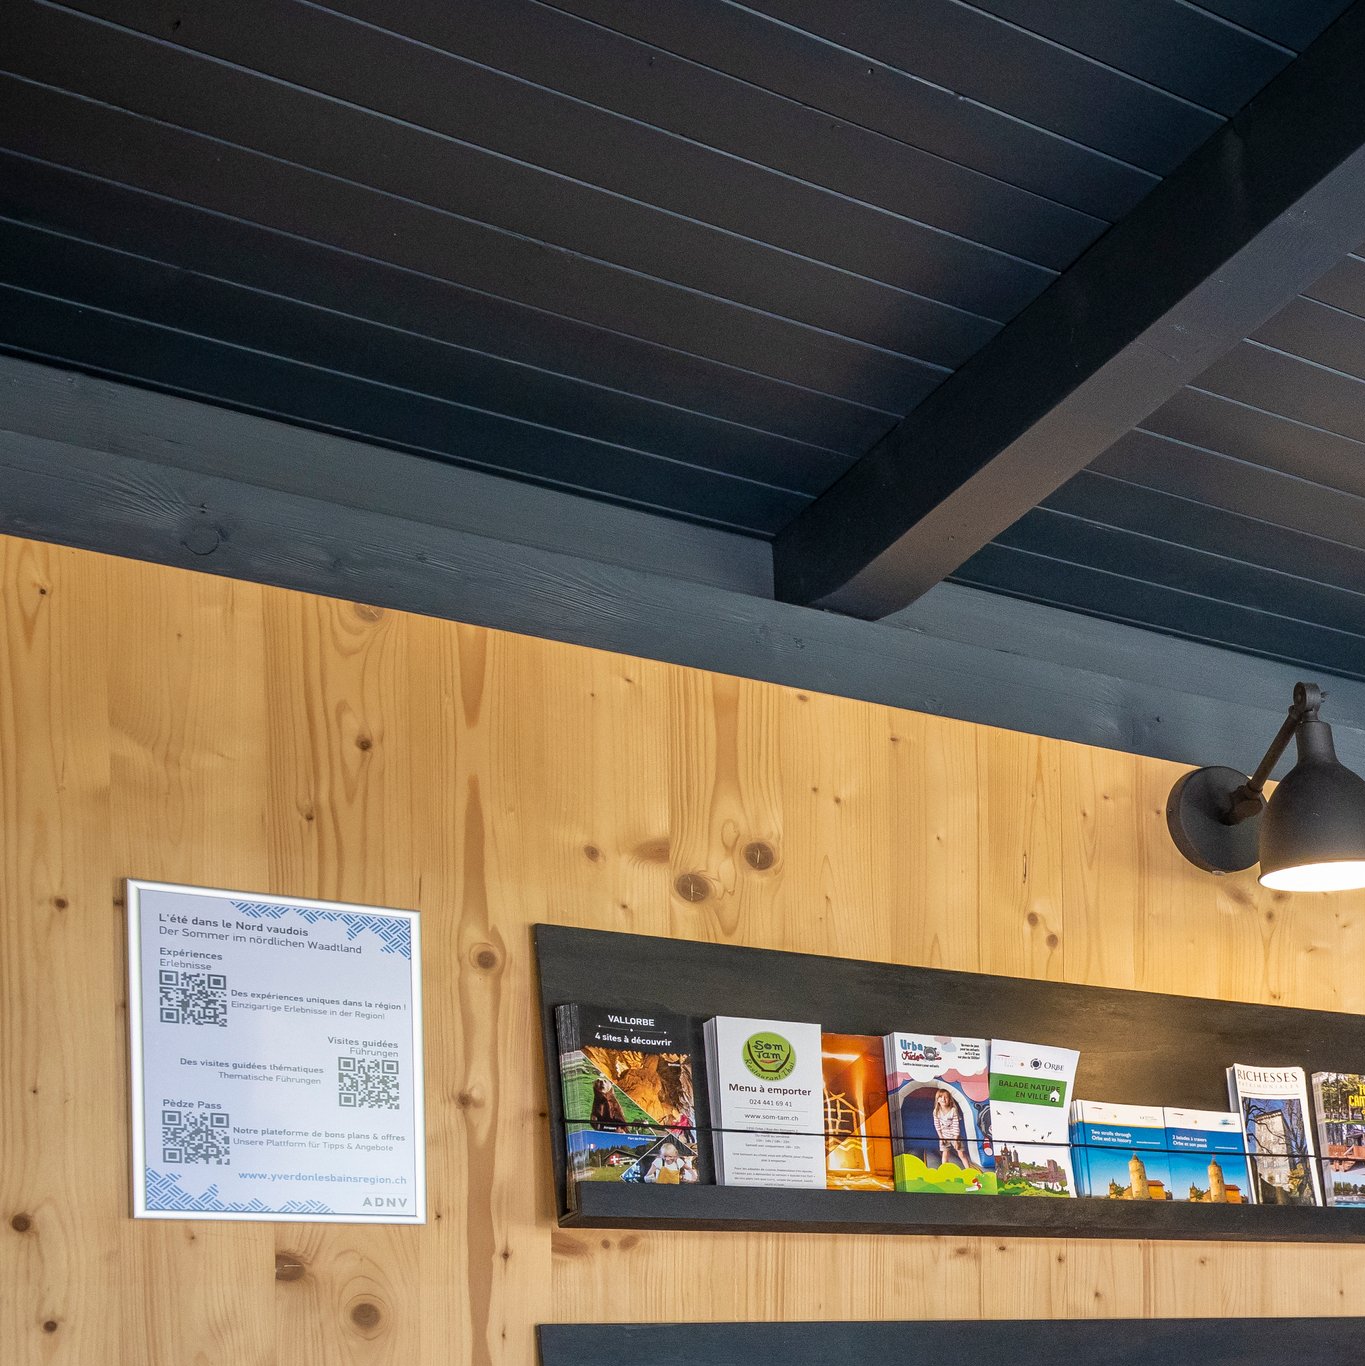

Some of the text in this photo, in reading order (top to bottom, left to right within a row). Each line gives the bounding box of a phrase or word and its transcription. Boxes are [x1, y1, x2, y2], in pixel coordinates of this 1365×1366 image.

[159, 913, 308, 936] L'été dans le Nord vaudois
[159, 926, 362, 954] Der Sommer im nördlichen Waadtland
[160, 948, 222, 961] Expériences
[160, 958, 212, 970] Erlebnisse
[231, 990, 402, 1011] Des expériences uniques dans la région
[231, 1000, 282, 1012] Einzigartige
[284, 1005, 327, 1016] Erlebnisse
[339, 1009, 352, 1017] der
[608, 1014, 655, 1026] VALLORBE
[328, 1036, 398, 1050] Visites guidées
[595, 1032, 672, 1046] 4 sites à découvrir
[900, 1039, 923, 1051] Urba
[350, 1046, 398, 1058] Führungen
[752, 1040, 784, 1052] Som
[754, 1050, 782, 1060] Tam
[180, 1058, 324, 1076] Des visites guidées thématiques
[218, 1072, 321, 1086] Thematische Führungen
[1237, 1069, 1298, 1082] RICHESSES
[728, 1083, 812, 1096] Menu à emporter
[999, 1080, 1060, 1093] BALADE NATURE
[1027, 1092, 1048, 1100] VILLE
[162, 1098, 222, 1110] Pèdze Pass
[233, 1126, 258, 1136] Notre
[261, 1128, 309, 1138] plateforme
[312, 1130, 322, 1138] de
[324, 1130, 345, 1139] bons
[347, 1131, 370, 1141] plans
[381, 1133, 406, 1142] offres
[233, 1138, 264, 1146] Unsere
[266, 1140, 306, 1148] Plattform
[308, 1140, 320, 1149] für
[322, 1142, 344, 1151] Tipps
[355, 1143, 394, 1152] Angebote
[238, 1171, 407, 1186] www.yverdonlesbainsregion.ch
[362, 1196, 408, 1208] ADNV
